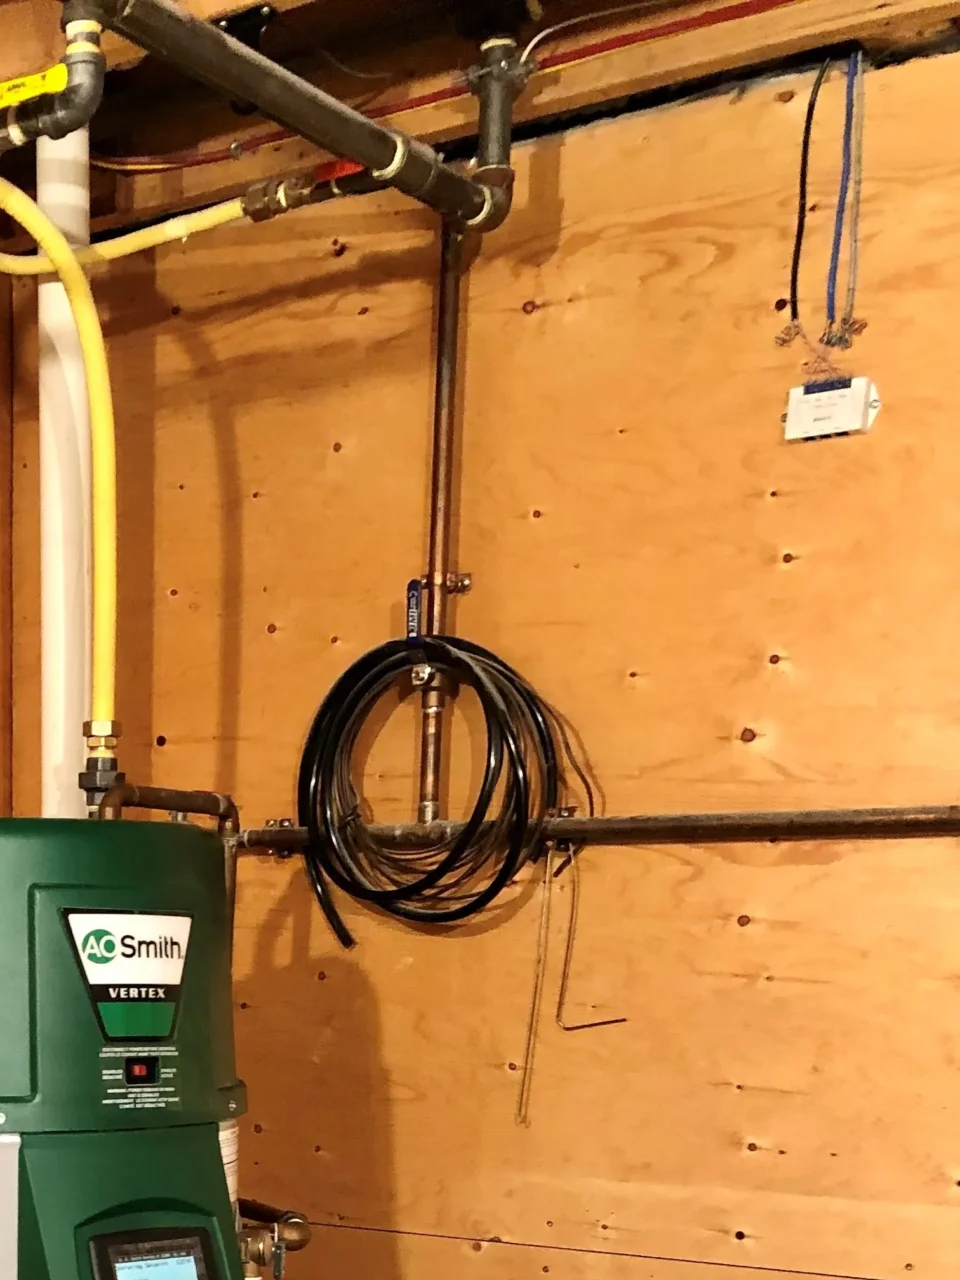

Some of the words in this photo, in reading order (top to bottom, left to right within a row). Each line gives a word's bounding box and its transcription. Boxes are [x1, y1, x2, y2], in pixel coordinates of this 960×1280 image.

[82, 934, 117, 958] AO
[120, 934, 181, 959] Smith
[108, 987, 166, 999] VERTEX
